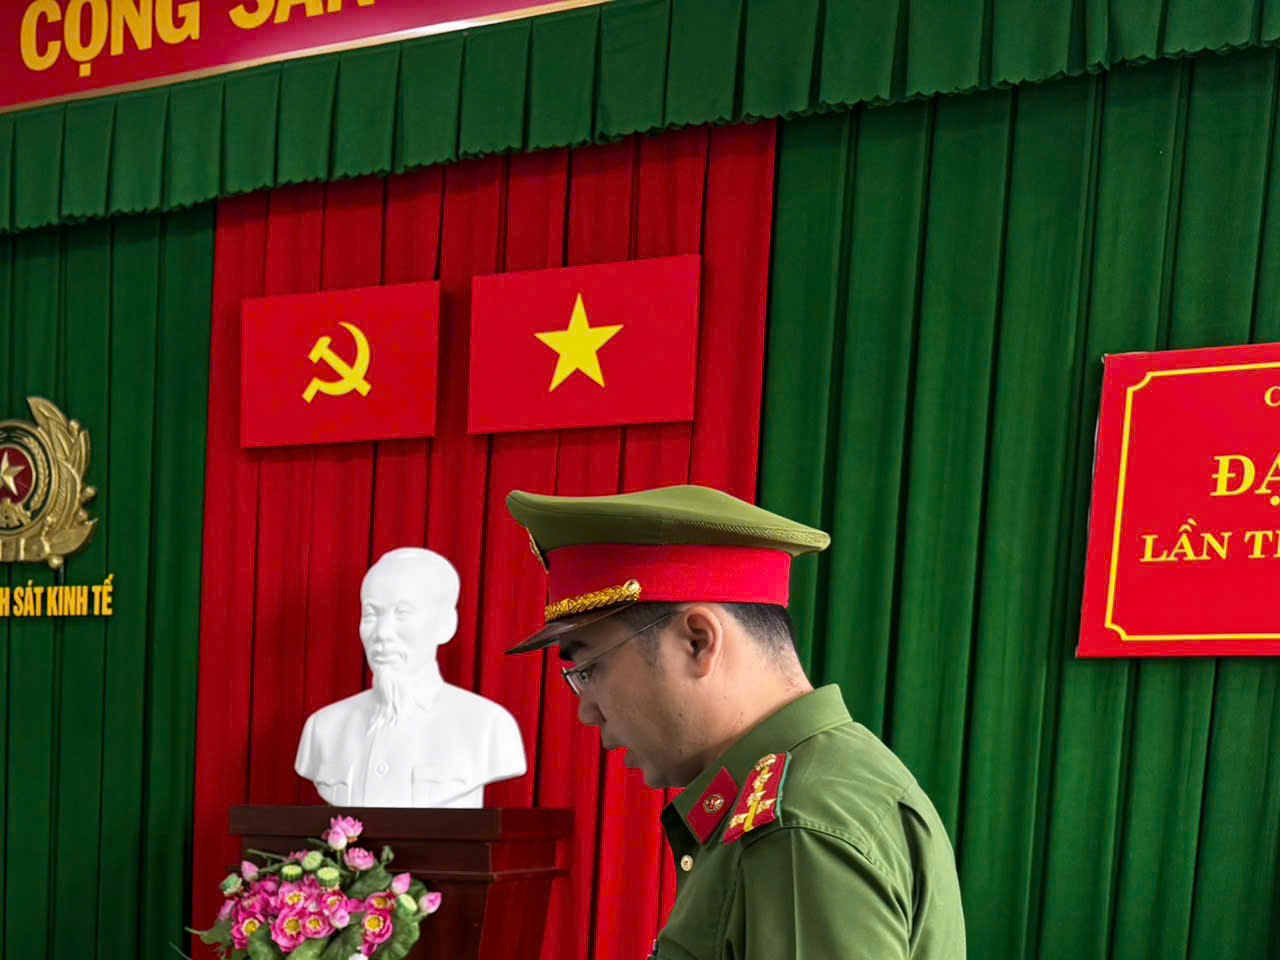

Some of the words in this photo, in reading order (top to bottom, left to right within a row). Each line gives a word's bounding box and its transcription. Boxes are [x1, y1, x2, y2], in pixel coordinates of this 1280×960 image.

[1140, 518, 1232, 562] LẦN
[13, 579, 44, 616] SÁT
[47, 586, 88, 616] KINH
[92, 574, 113, 615] TẾ
